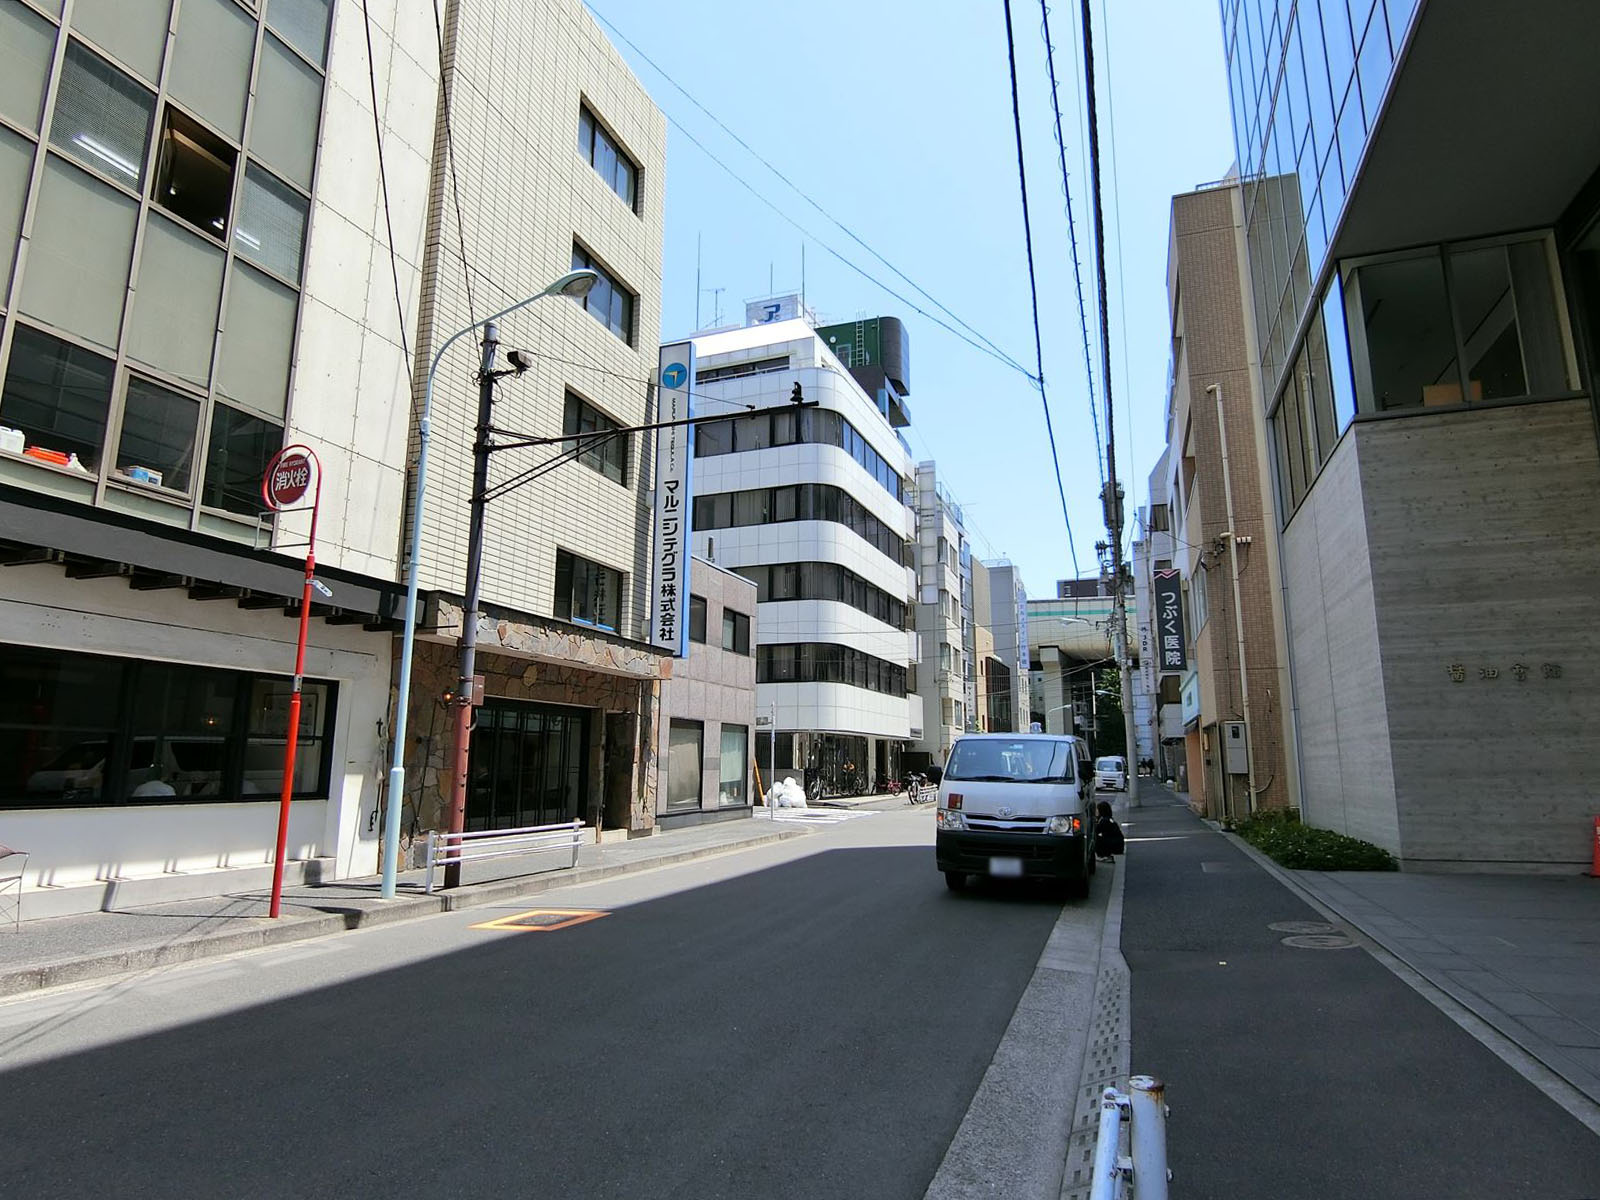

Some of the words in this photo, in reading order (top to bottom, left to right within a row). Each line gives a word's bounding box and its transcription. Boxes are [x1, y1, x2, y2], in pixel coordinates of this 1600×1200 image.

[275, 467, 308, 491] 消火栓
[659, 479, 680, 641] マルニシテグラ株式会社
[1161, 592, 1182, 666] つぶく医院
